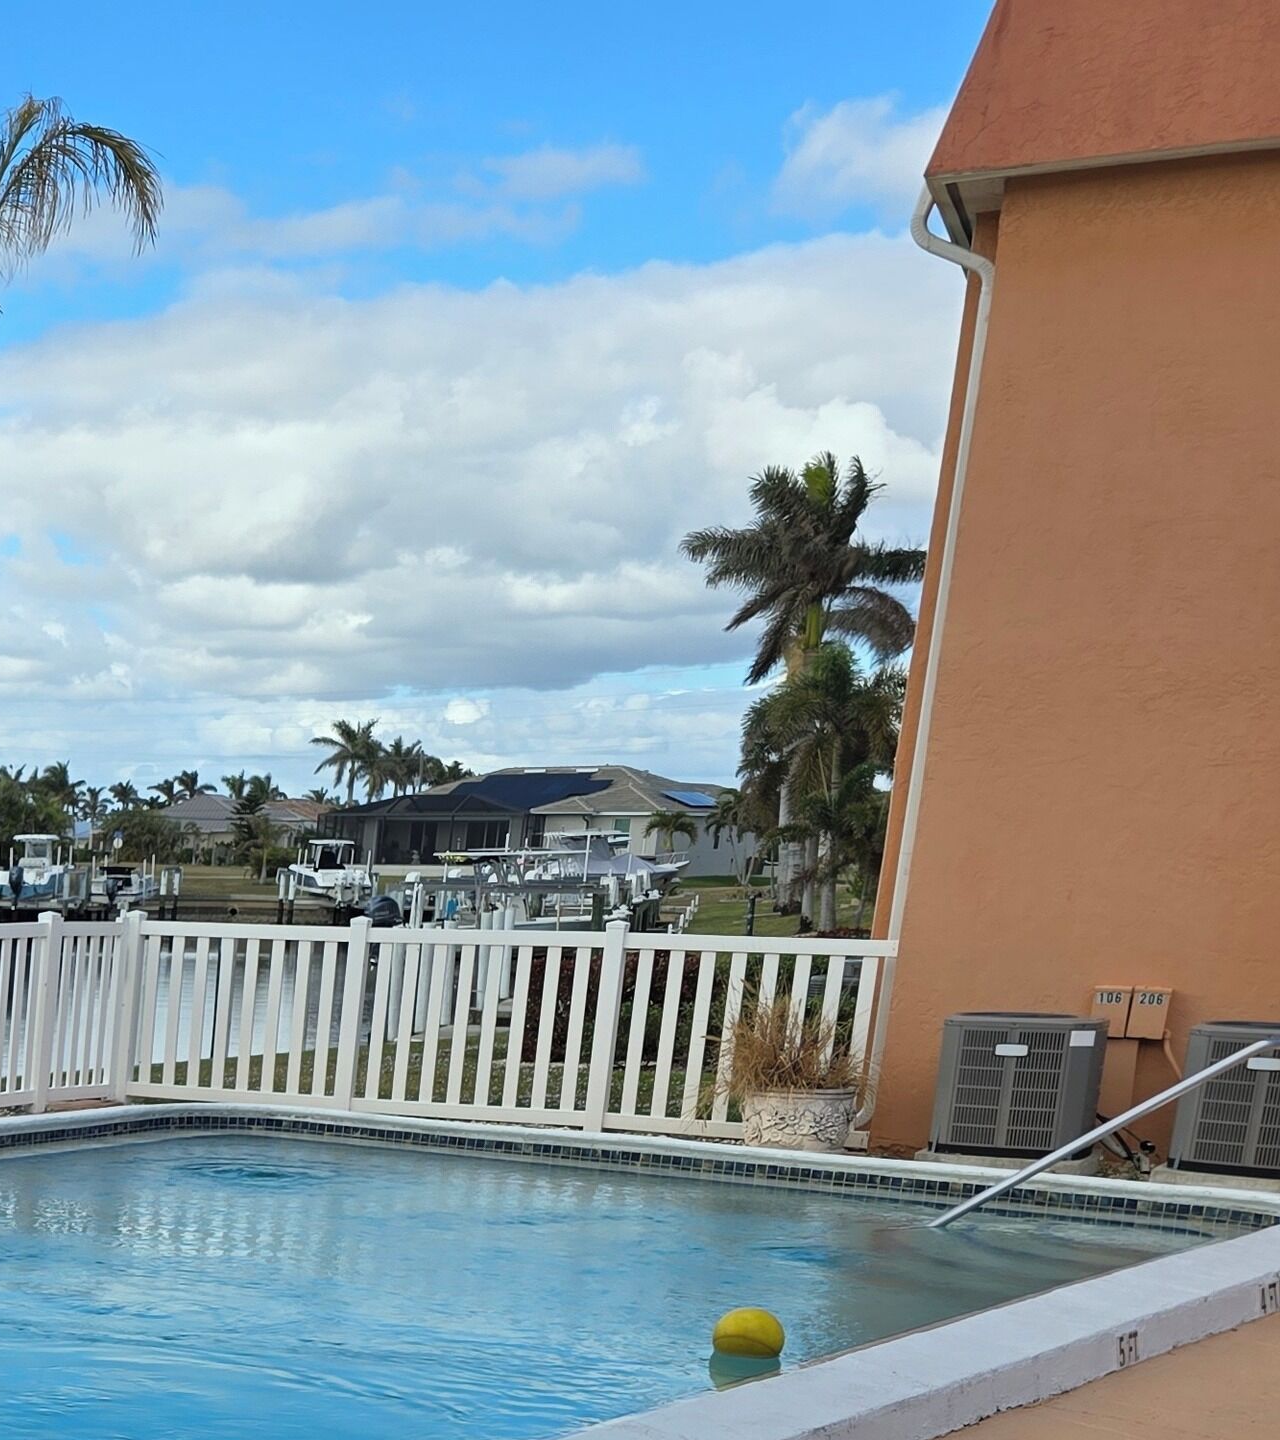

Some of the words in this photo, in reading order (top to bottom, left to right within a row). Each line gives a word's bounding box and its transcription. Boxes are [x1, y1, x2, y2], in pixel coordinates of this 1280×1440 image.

[1099, 992, 1122, 1004] 106
[1140, 993, 1163, 1005] 206
[1119, 1333, 1126, 1367] 5
